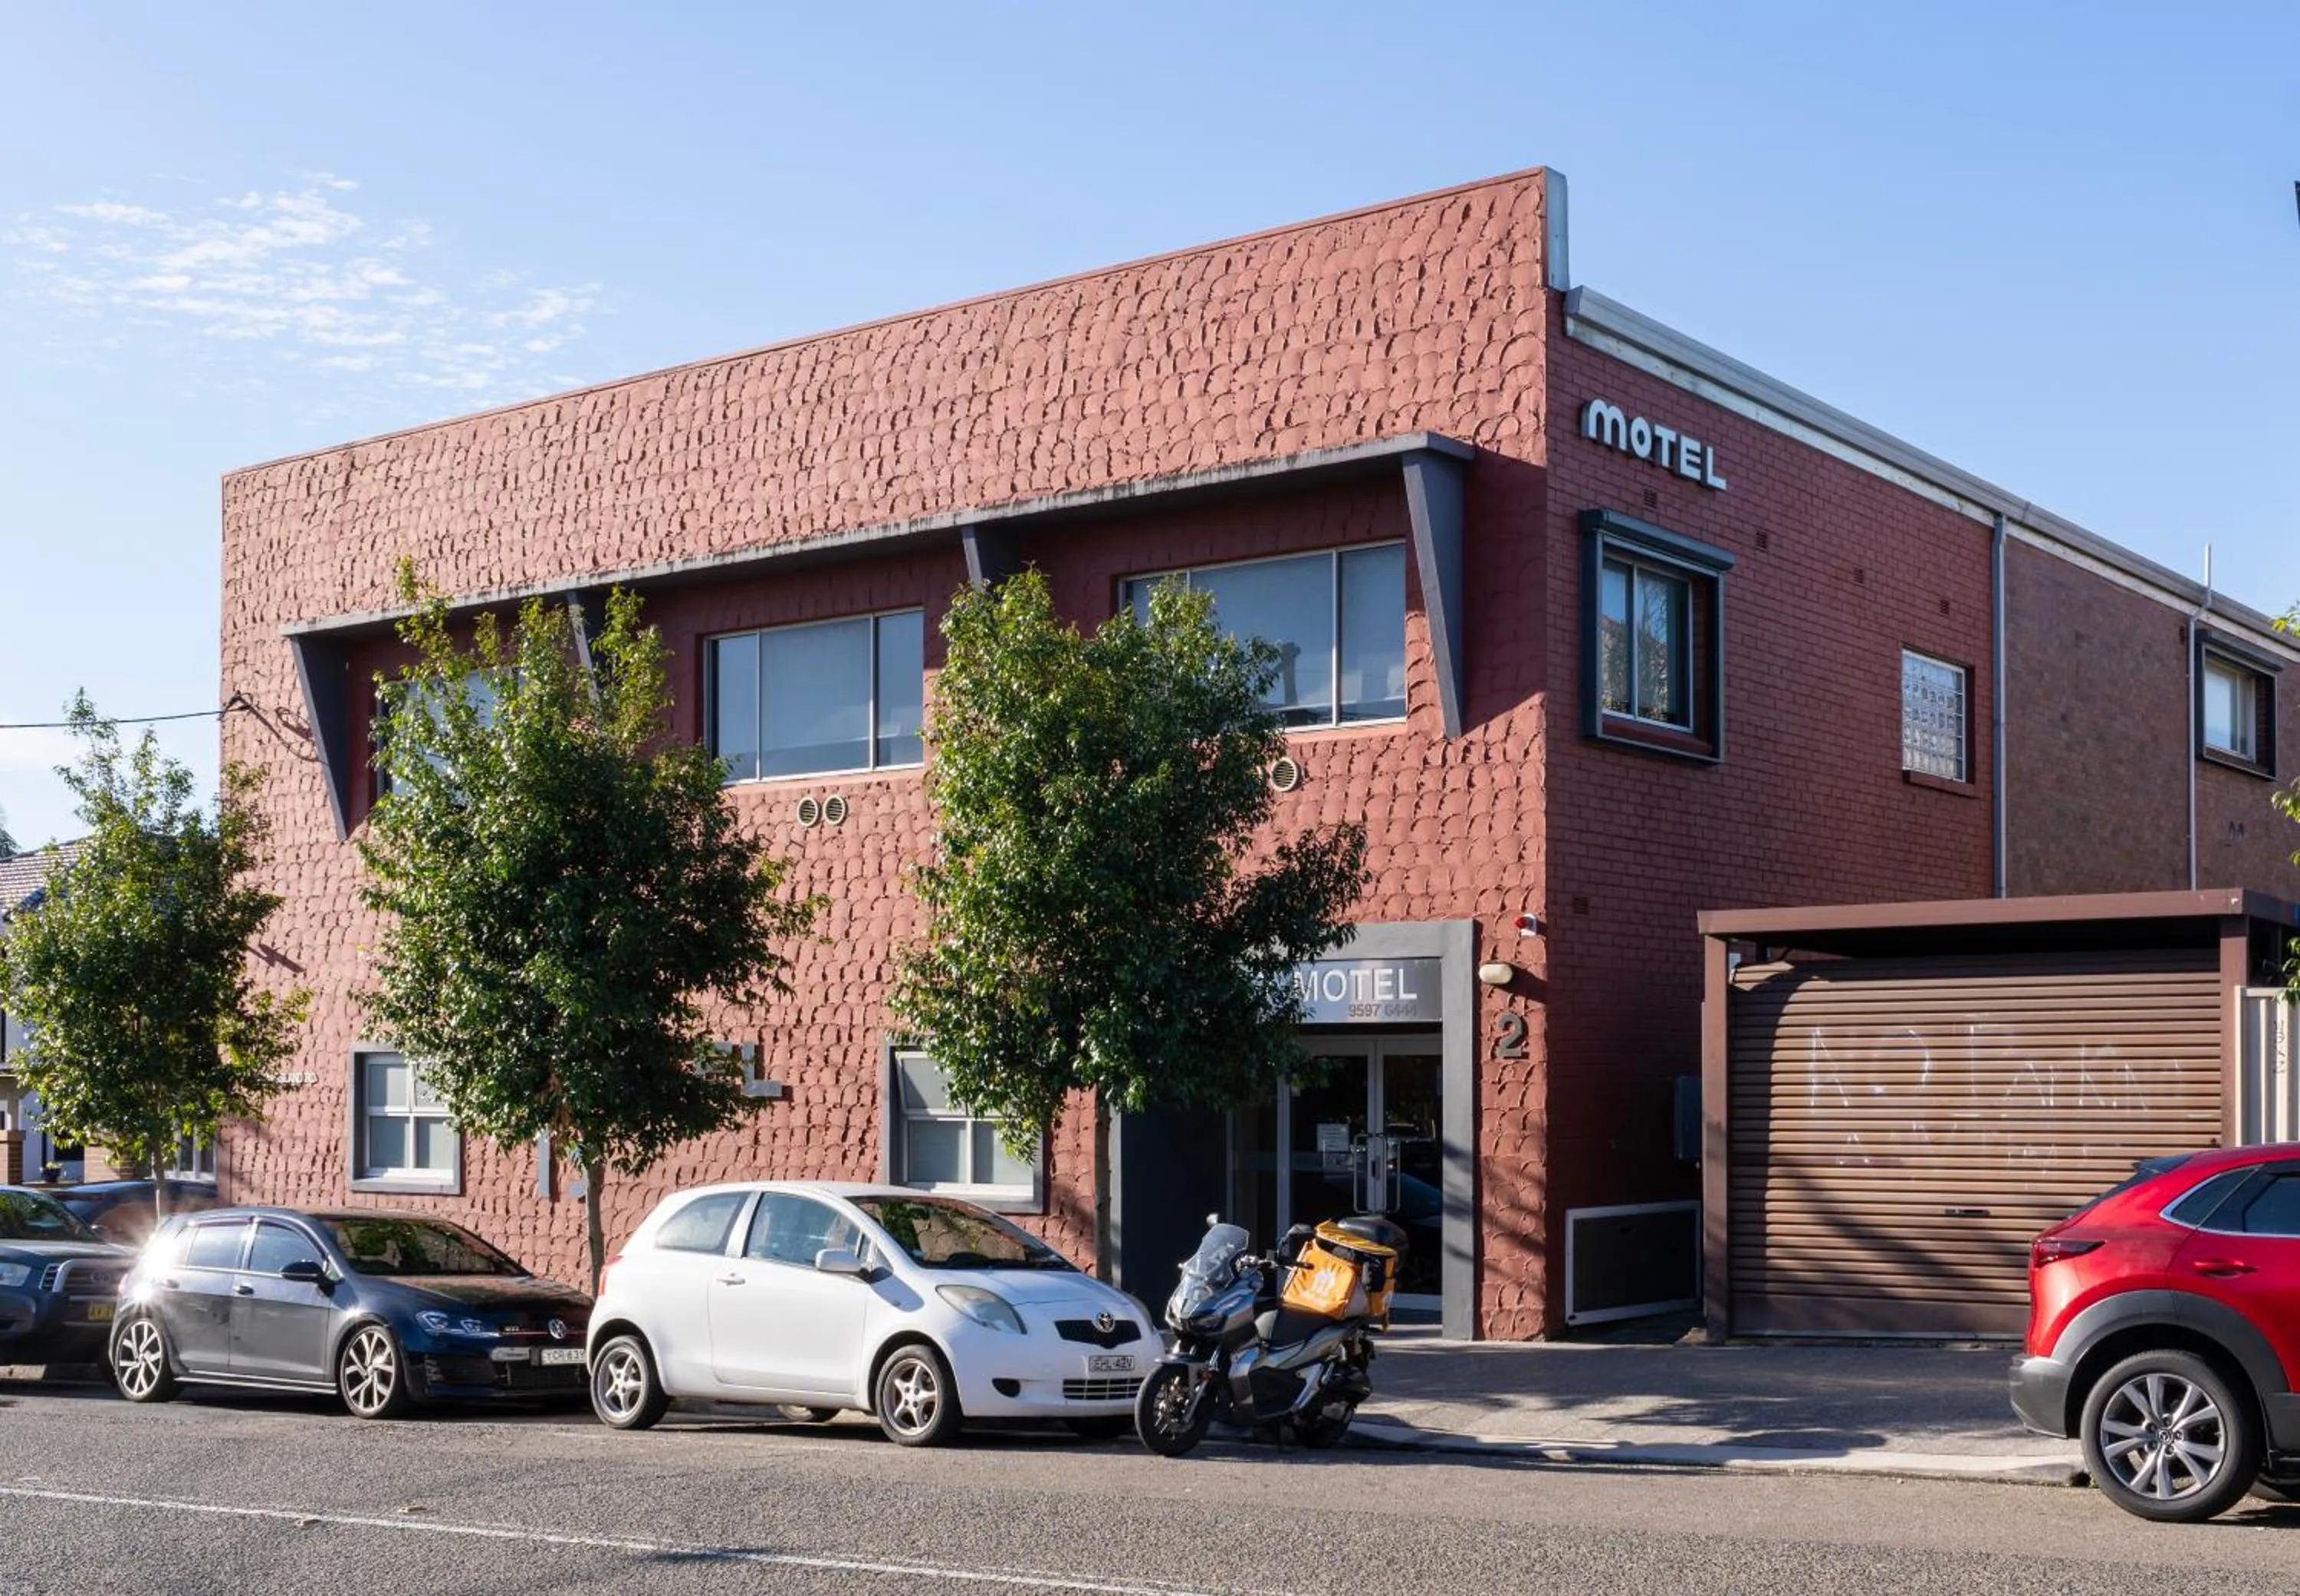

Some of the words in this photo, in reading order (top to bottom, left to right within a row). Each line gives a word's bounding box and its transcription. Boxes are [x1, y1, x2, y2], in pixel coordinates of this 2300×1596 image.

[1582, 398, 1727, 491] MOTEL
[1294, 968, 1417, 1002] MOTEL
[1349, 1003, 1379, 1017] 9597
[1496, 1012, 1522, 1057] 2
